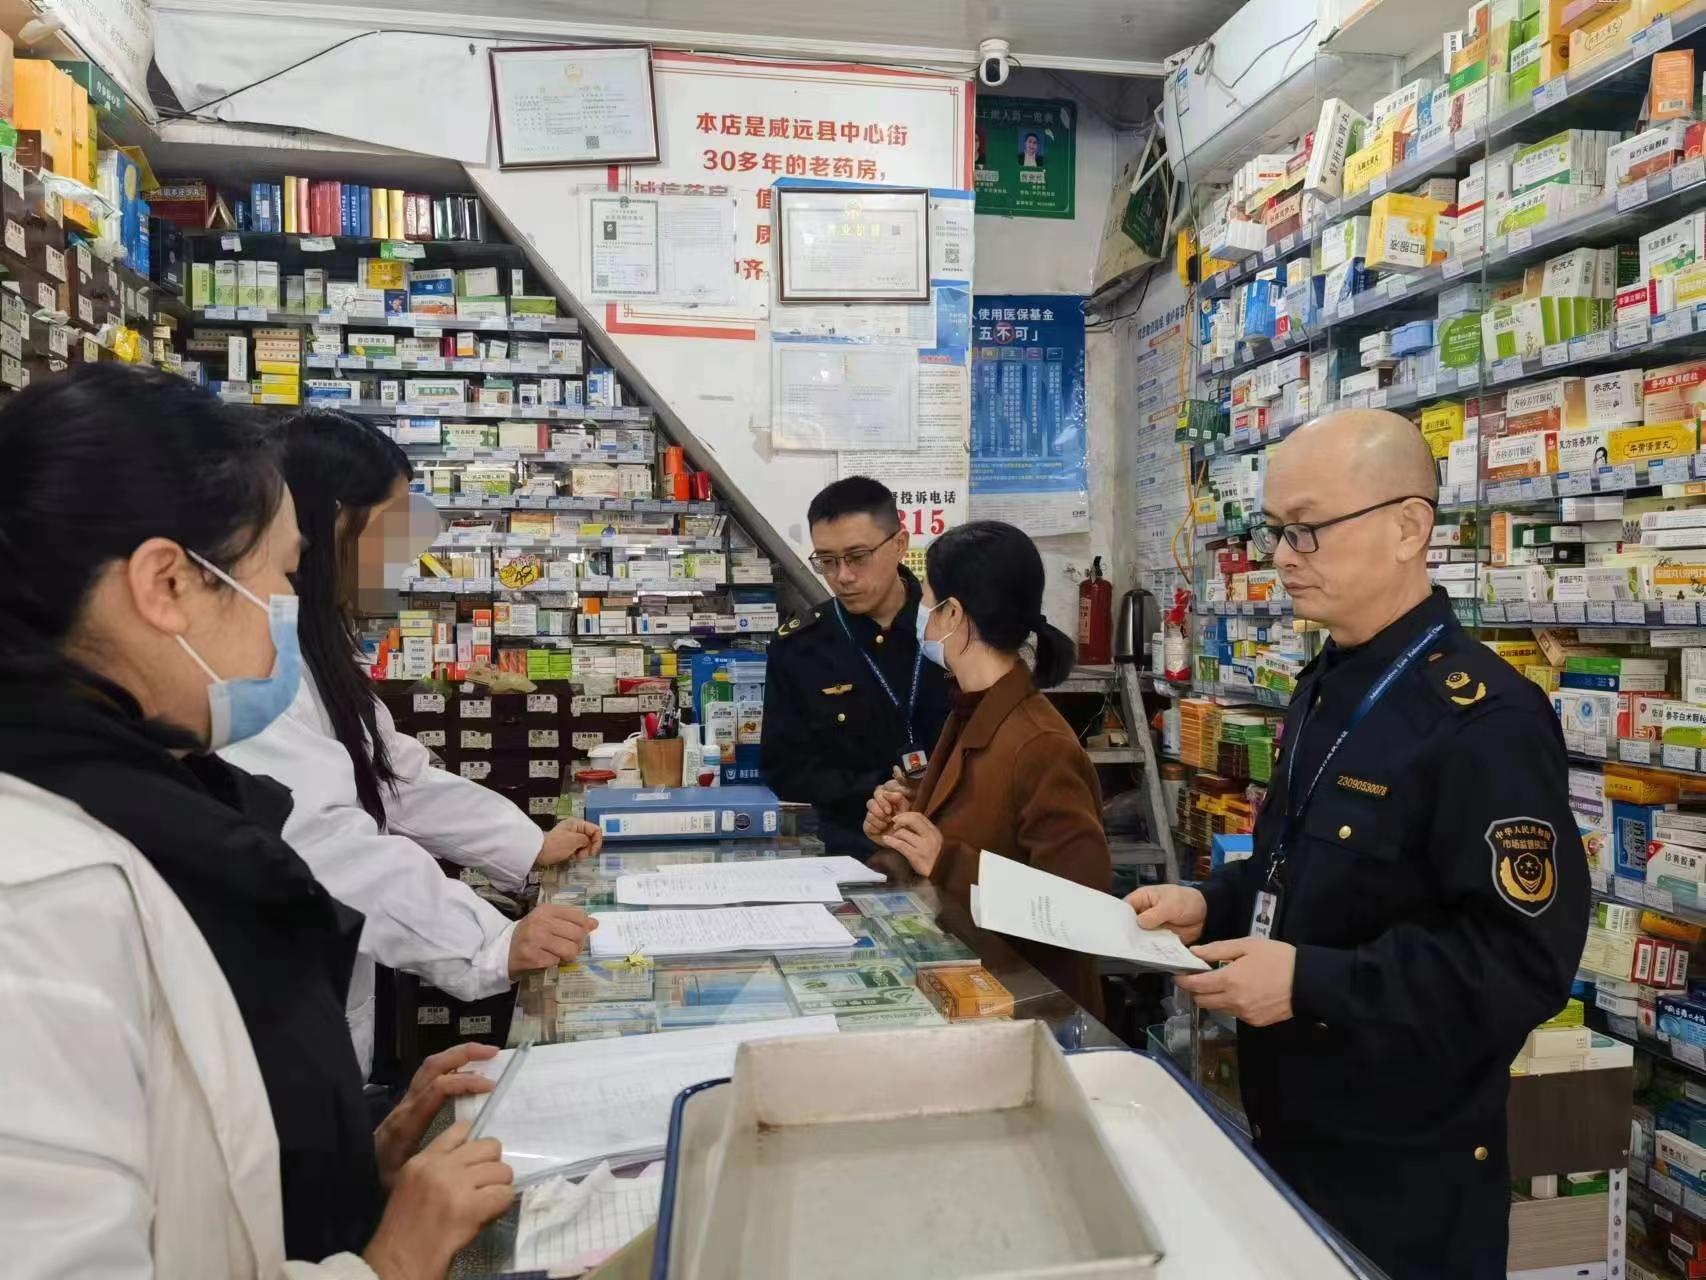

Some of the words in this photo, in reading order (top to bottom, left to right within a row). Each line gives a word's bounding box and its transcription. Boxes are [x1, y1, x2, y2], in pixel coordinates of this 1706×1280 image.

[696, 112, 908, 147] 本店是威远县中心街
[1328, 112, 1351, 176] 舒肝和胃丸
[1370, 668, 1398, 700] Administrative
[1494, 825, 1551, 841] 中华人民共和国
